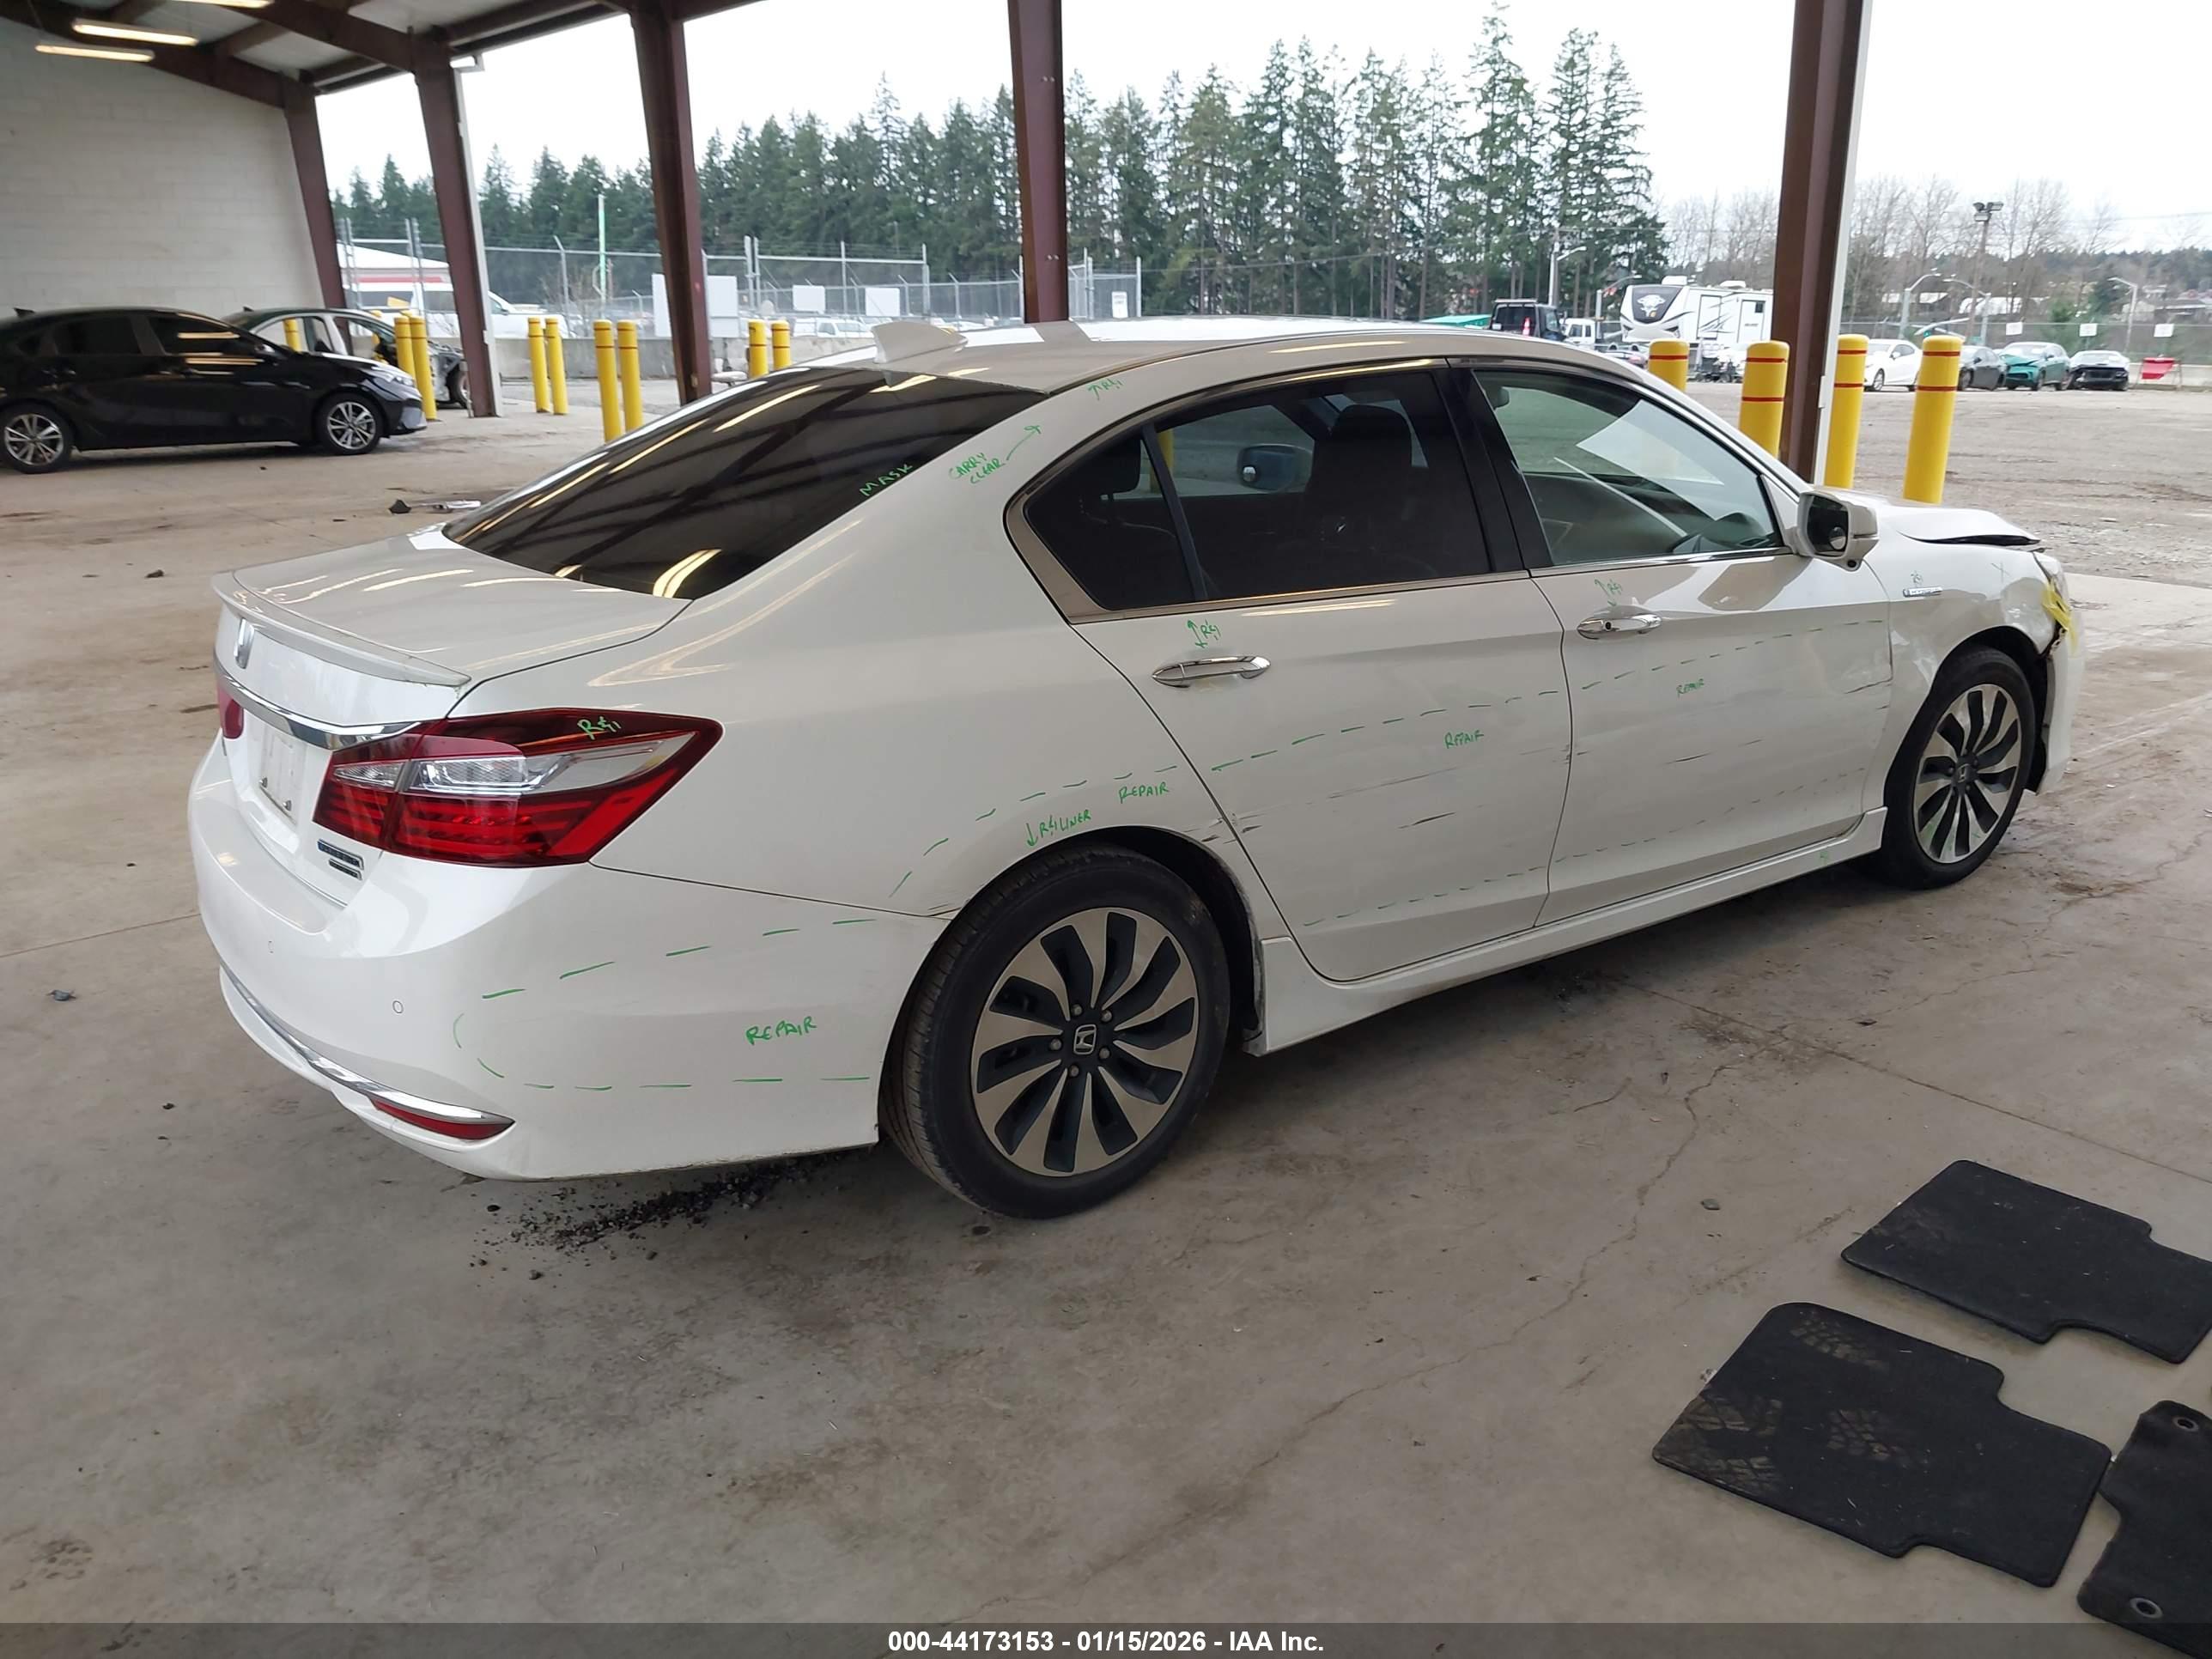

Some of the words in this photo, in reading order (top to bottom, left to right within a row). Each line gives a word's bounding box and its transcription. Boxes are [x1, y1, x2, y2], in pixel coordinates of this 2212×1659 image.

[948, 453, 987, 479] CARRY
[969, 458, 1006, 484] CLEAR
[860, 464, 914, 495] MASK
[1118, 781, 1170, 804] REPAIR
[745, 1016, 817, 1045] REPAIR
